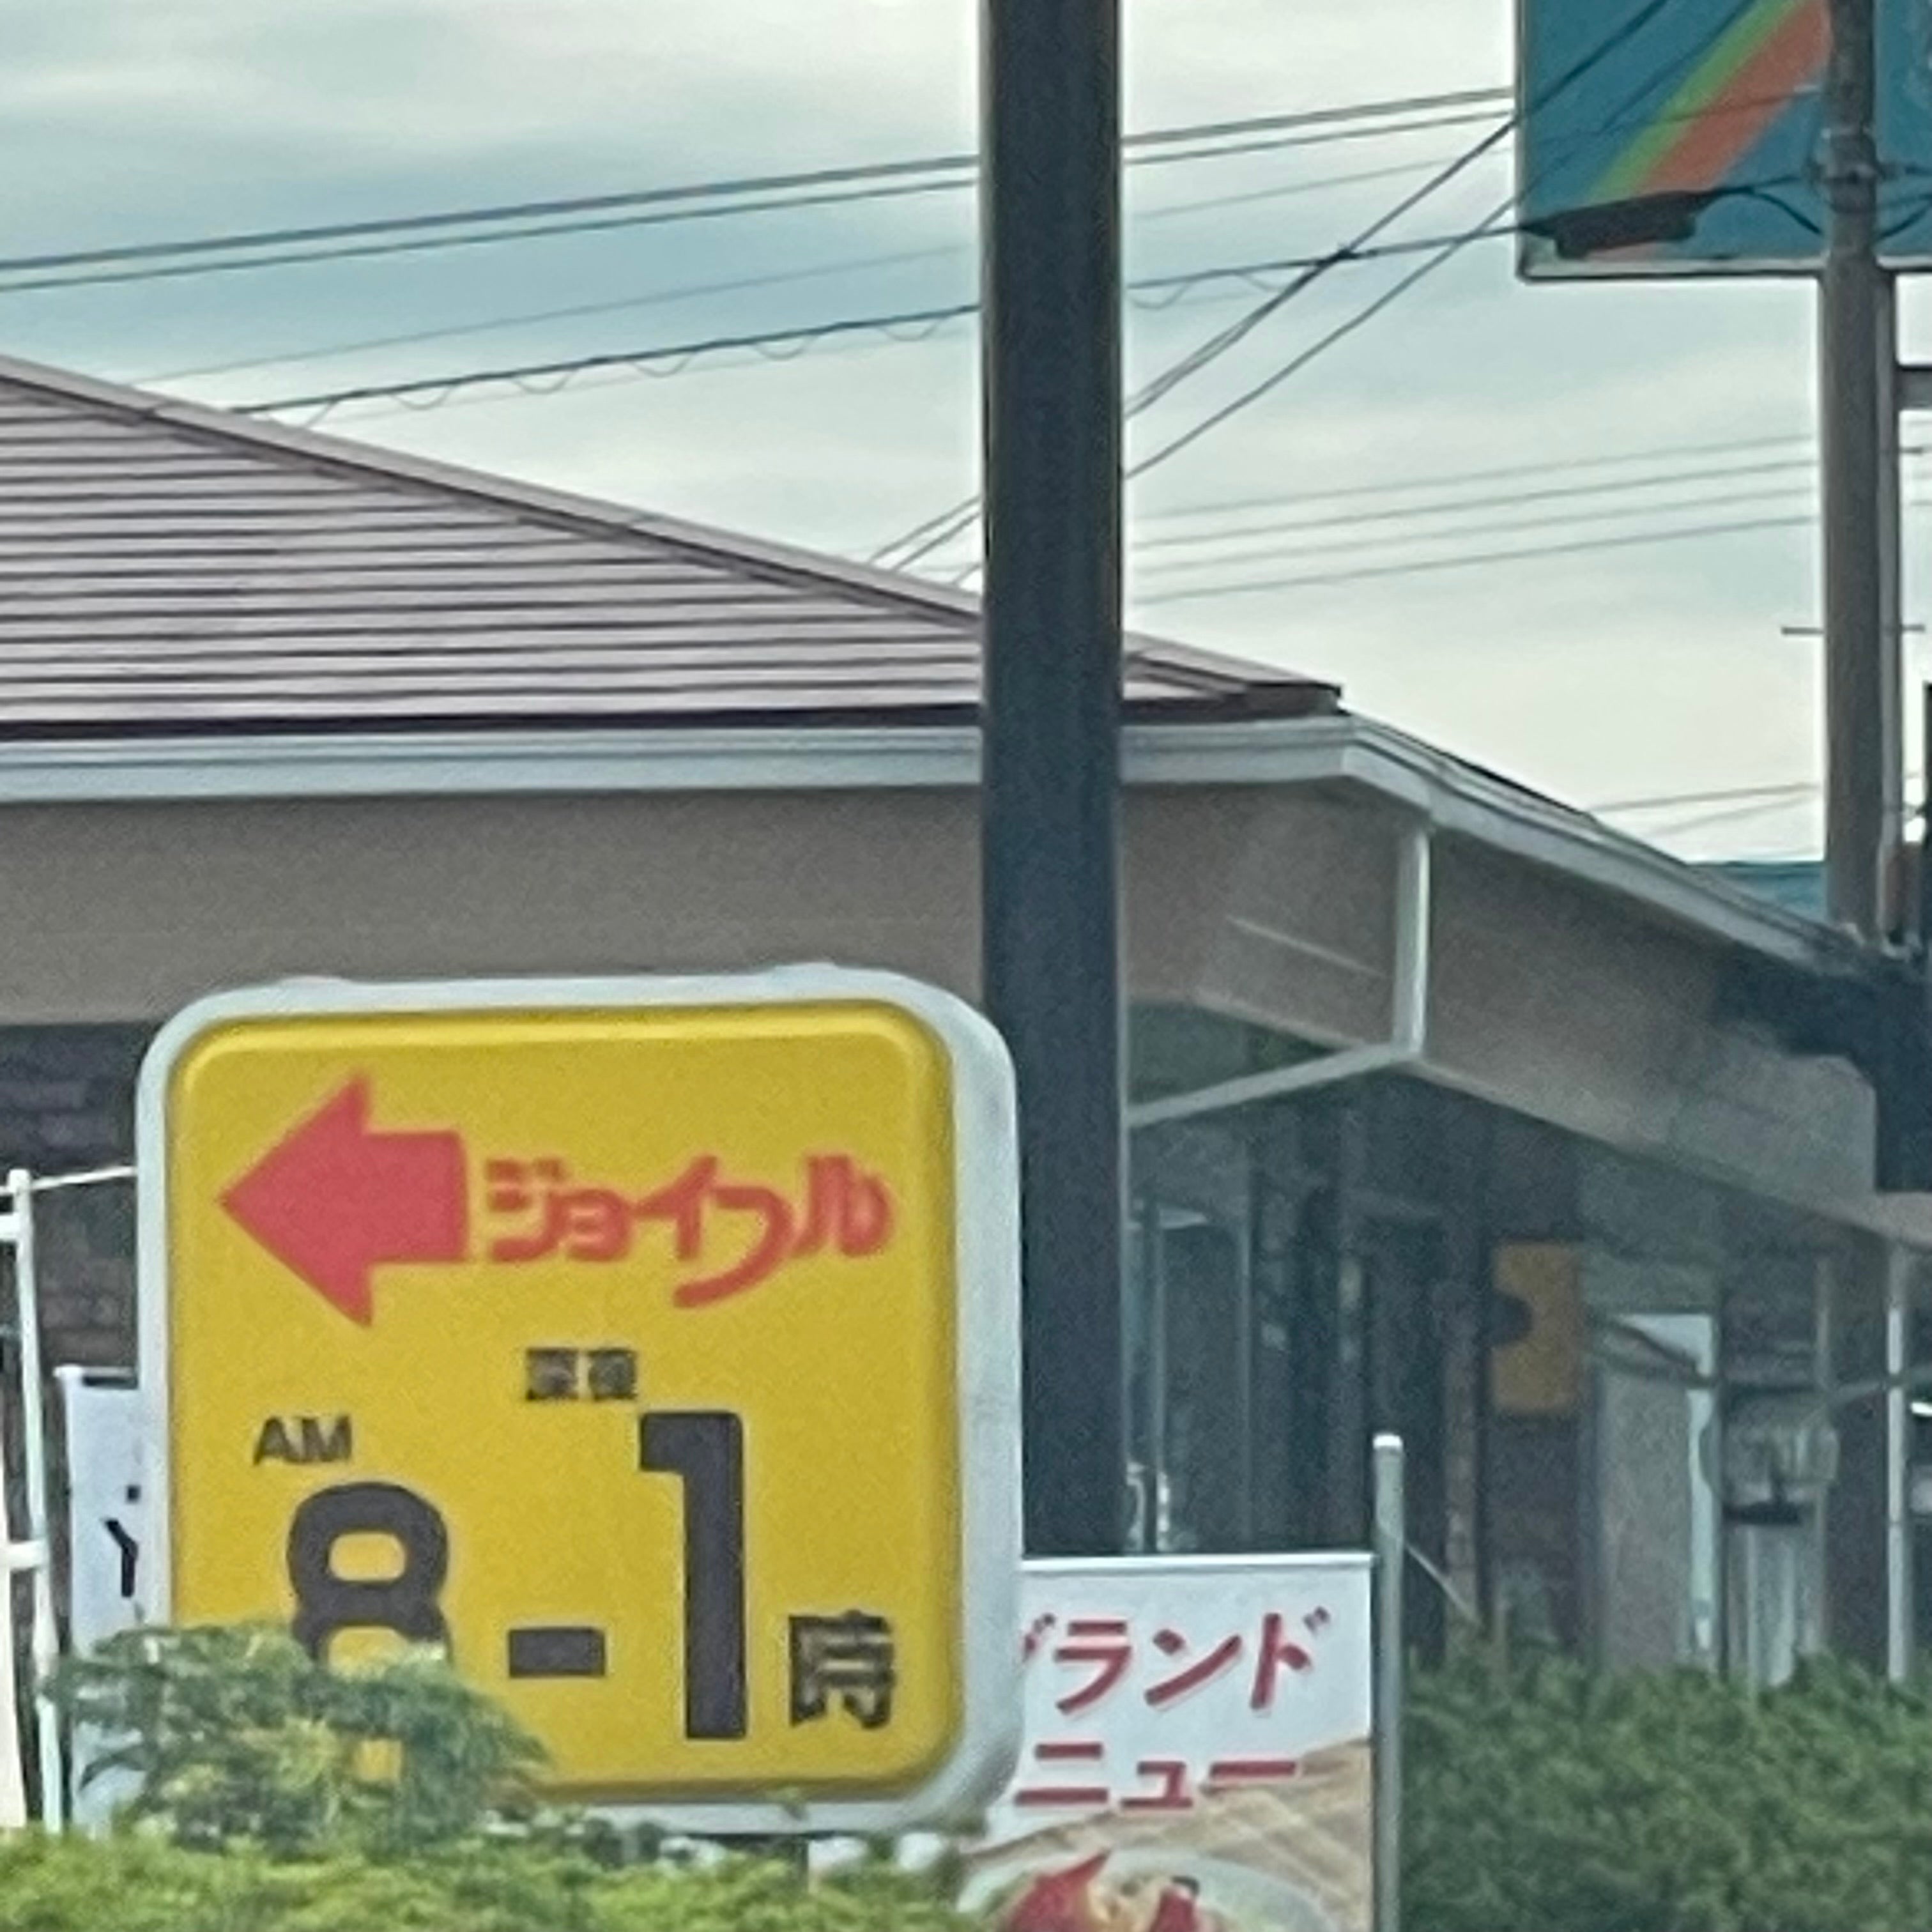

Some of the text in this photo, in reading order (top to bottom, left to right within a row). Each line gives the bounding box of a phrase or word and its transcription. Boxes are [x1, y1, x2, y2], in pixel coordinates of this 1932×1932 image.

[486, 1153, 893, 1307] ジョイフル
[253, 1416, 353, 1465] AM
